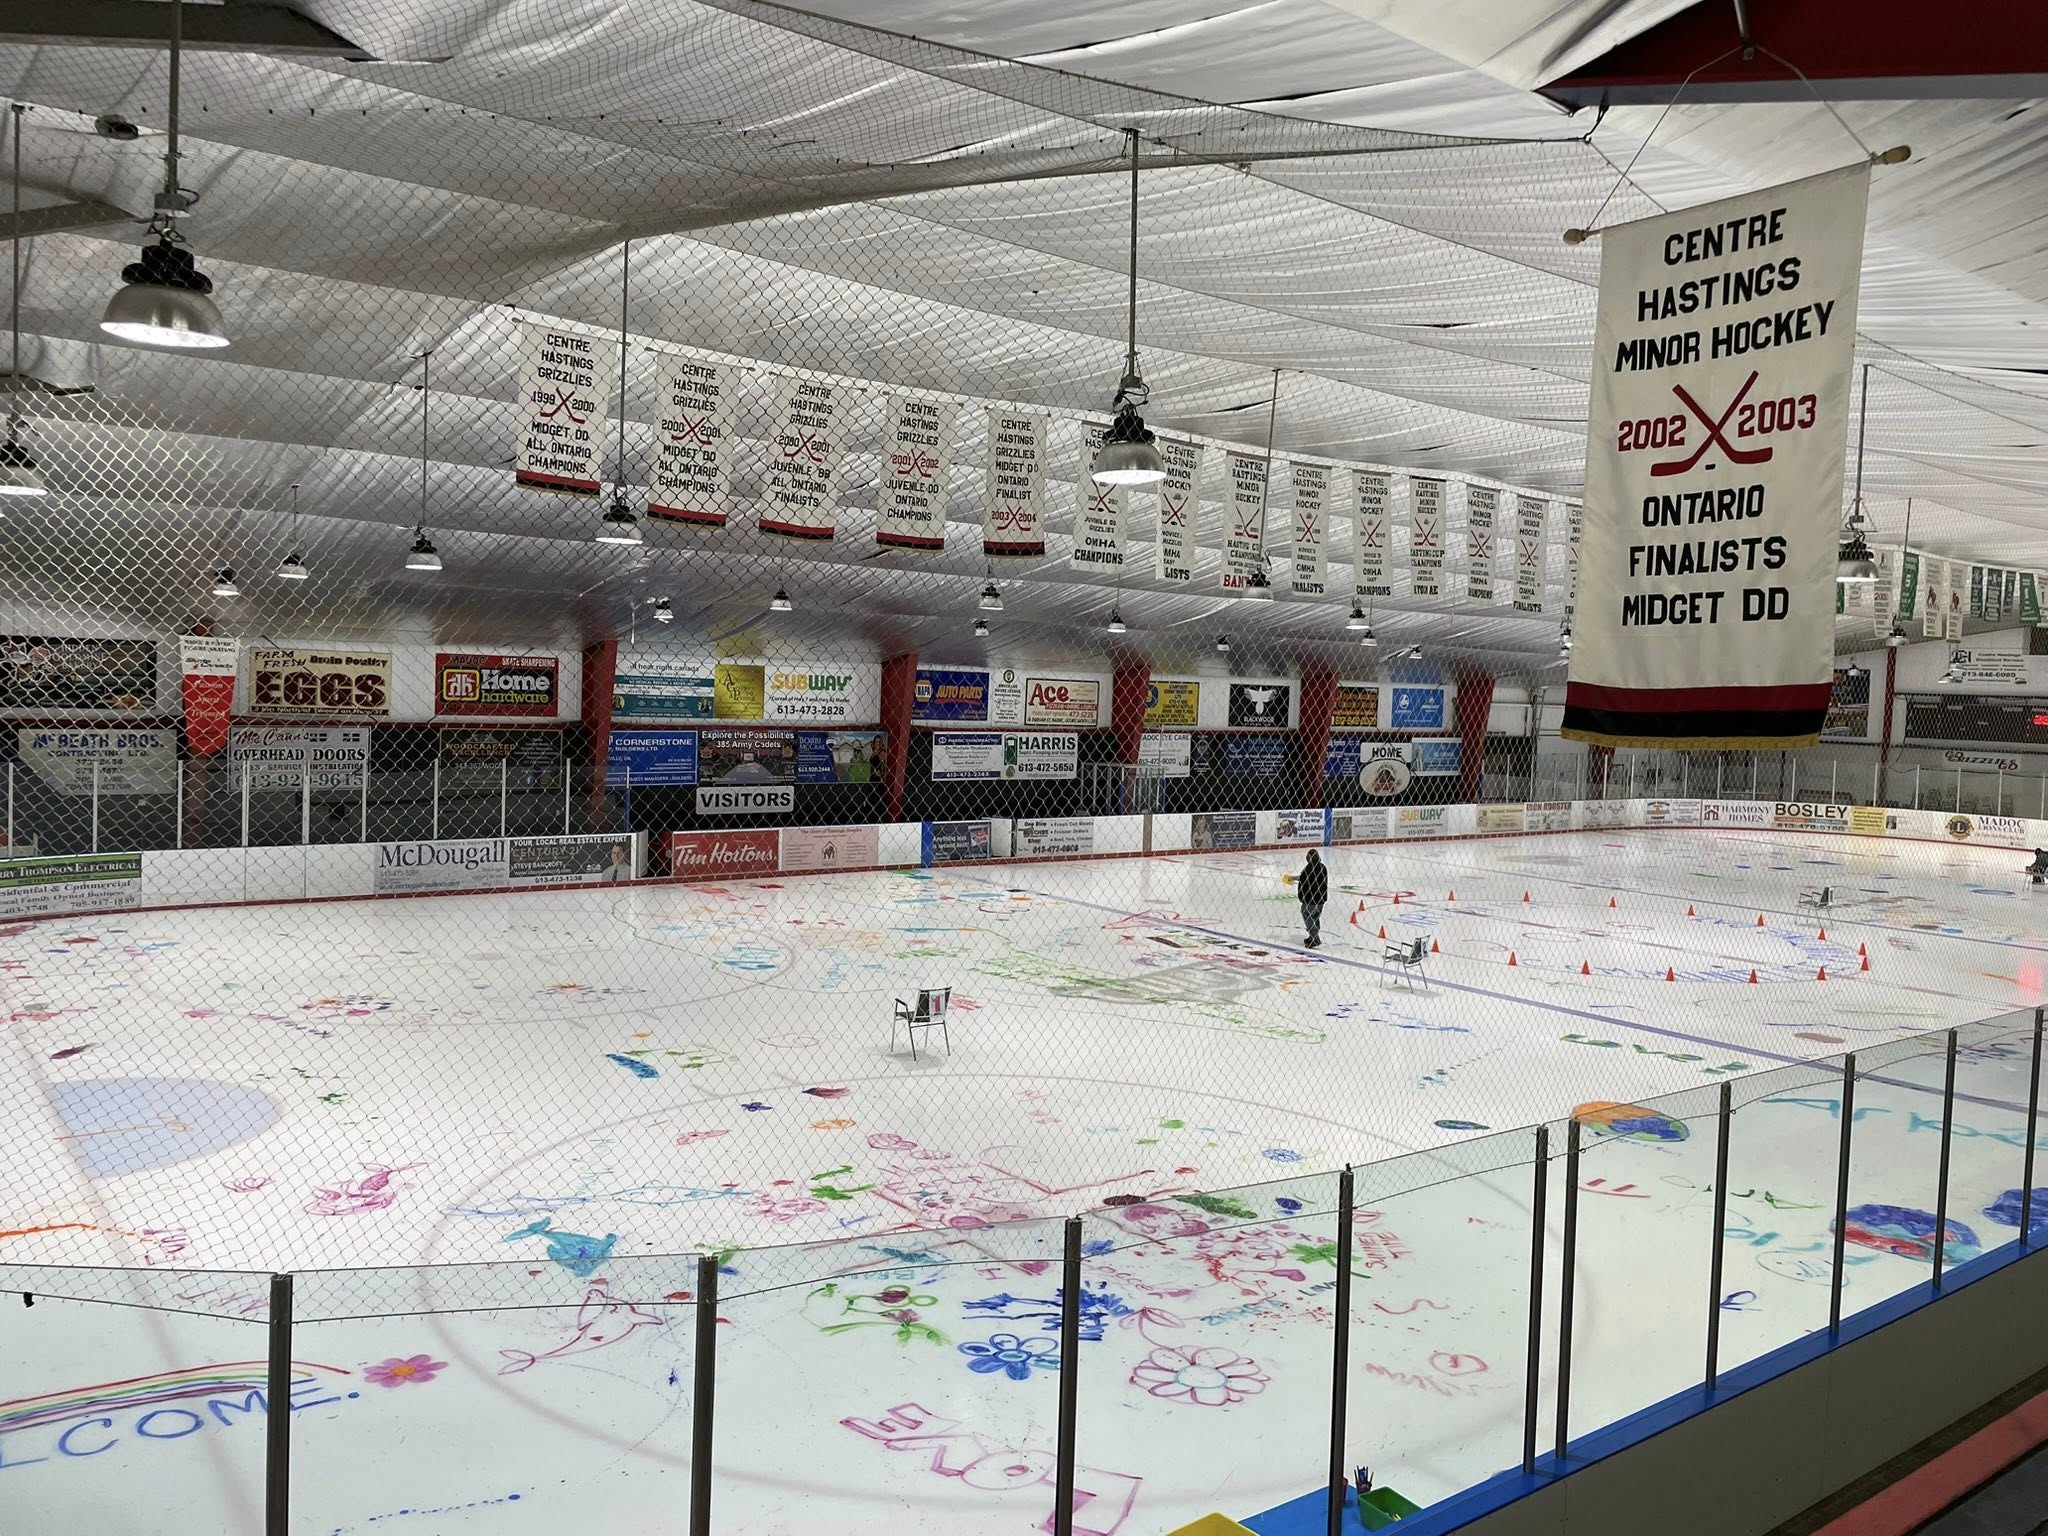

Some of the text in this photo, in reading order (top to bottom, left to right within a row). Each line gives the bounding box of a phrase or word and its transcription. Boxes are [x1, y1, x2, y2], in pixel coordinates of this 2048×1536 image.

[1663, 208, 1787, 266] CENTRE
[1638, 257, 1801, 322] HASTINGS
[547, 334, 590, 353] CENTRE
[1615, 301, 1834, 373] MINOR HOCKEY
[541, 350, 594, 370] HASTINGS
[538, 367, 592, 387] GRIZZLIES
[682, 364, 716, 380] CENTRE
[674, 379, 719, 396] HASTINGS
[799, 384, 831, 399] CENTRE
[533, 391, 594, 413] 1999 2000
[673, 395, 716, 411] GRIZZLIES
[791, 399, 833, 414] HASTINGS
[905, 403, 939, 417] CENTRE
[790, 414, 828, 429] GRIZZLIES
[900, 417, 939, 431] HASTINGS
[1001, 419, 1032, 431] CENTRE
[1618, 394, 1817, 451] 2002 2003
[532, 422, 589, 441] MIDGET DD
[662, 419, 721, 438] 2000 2001
[779, 435, 830, 452] 2000 2001
[897, 431, 939, 446] GRIZZLIES
[998, 432, 1034, 445] HASTINGS
[527, 438, 591, 458] ALL ONTARIO
[663, 445, 697, 459] MIDGET
[996, 447, 1035, 459] GRIZZLIES
[1167, 445, 1195, 458] CENTRE
[528, 455, 586, 473] CHAMPIONS
[892, 454, 939, 468] 2001 2002
[996, 461, 1023, 472] MIDGET
[1235, 459, 1263, 472] CENTRE
[659, 461, 718, 477] ALL ONTARIO
[771, 461, 812, 476] JUVENILE
[1167, 468, 1191, 479] MINOR
[1297, 469, 1323, 479] CENTRE
[998, 475, 1029, 486] ONTARIO
[1232, 469, 1266, 482] HASTINGS
[1361, 477, 1384, 486] CENTRE
[659, 475, 715, 493] CHAMPIONS
[771, 477, 827, 493] ALL ONTARIO
[886, 480, 925, 493] JUVENILE
[1163, 480, 1191, 491] HOCKEY
[1237, 481, 1260, 493] MINOR
[1293, 478, 1327, 490] HASTINGS
[775, 492, 819, 507] FINALISTS
[895, 494, 928, 507] ONTARIO
[996, 489, 1032, 500] FINALIST
[1235, 493, 1260, 504] HOCKEY
[1299, 489, 1319, 499] MINOR
[1361, 496, 1382, 505] MINOR
[1296, 500, 1321, 511] HOCKEY
[1642, 484, 1765, 527] ONTARIO
[887, 508, 932, 522] CHAMPIONS
[992, 510, 1037, 523] 2003 2004
[1085, 537, 1116, 548] OMHA
[1074, 549, 1123, 564] CHAMPIONS
[1629, 536, 1787, 577] FINALISTS
[1356, 585, 1391, 596] CHAMPIONS
[1622, 586, 1789, 627] MIDGET DD
[255, 651, 294, 659] FARM
[264, 659, 306, 669] FRESH
[345, 657, 388, 668] Poultry
[502, 657, 556, 667] SKATE SHARPENING
[481, 669, 550, 691] Home
[771, 673, 851, 691] SUBWAY
[256, 671, 386, 707] EGGS
[917, 685, 930, 696] NAPA
[936, 685, 983, 699] AUTO PARTS
[1028, 683, 1069, 705] Ace
[481, 690, 549, 703] hardware
[777, 705, 845, 715] 613-473-2828
[117, 734, 164, 748] BROS.
[702, 731, 794, 739] Explore the Possibilities
[732, 741, 752, 749] Army
[1019, 737, 1076, 749] HARRIS
[234, 749, 365, 760] OVERHEAD DOORS
[1372, 748, 1402, 757] HOME
[1945, 751, 1963, 760] GO
[1018, 763, 1074, 772] 613-472-5650
[1947, 757, 2016, 765] GRIZZLIES
[700, 792, 791, 808] VISITORS
[1400, 808, 1444, 820] SUBWAY
[1721, 804, 1771, 814] HARMONY
[1775, 804, 1847, 818] BOSLEY
[1729, 813, 1763, 821] HOMES
[1980, 817, 2025, 828] MADOC
[380, 841, 506, 870] McDougall
[512, 848, 566, 857] CENTURY
[675, 843, 707, 867] Tim
[20, 862, 139, 877] THOMPSON ELECTRICAL
[64, 880, 131, 892] Commercial
